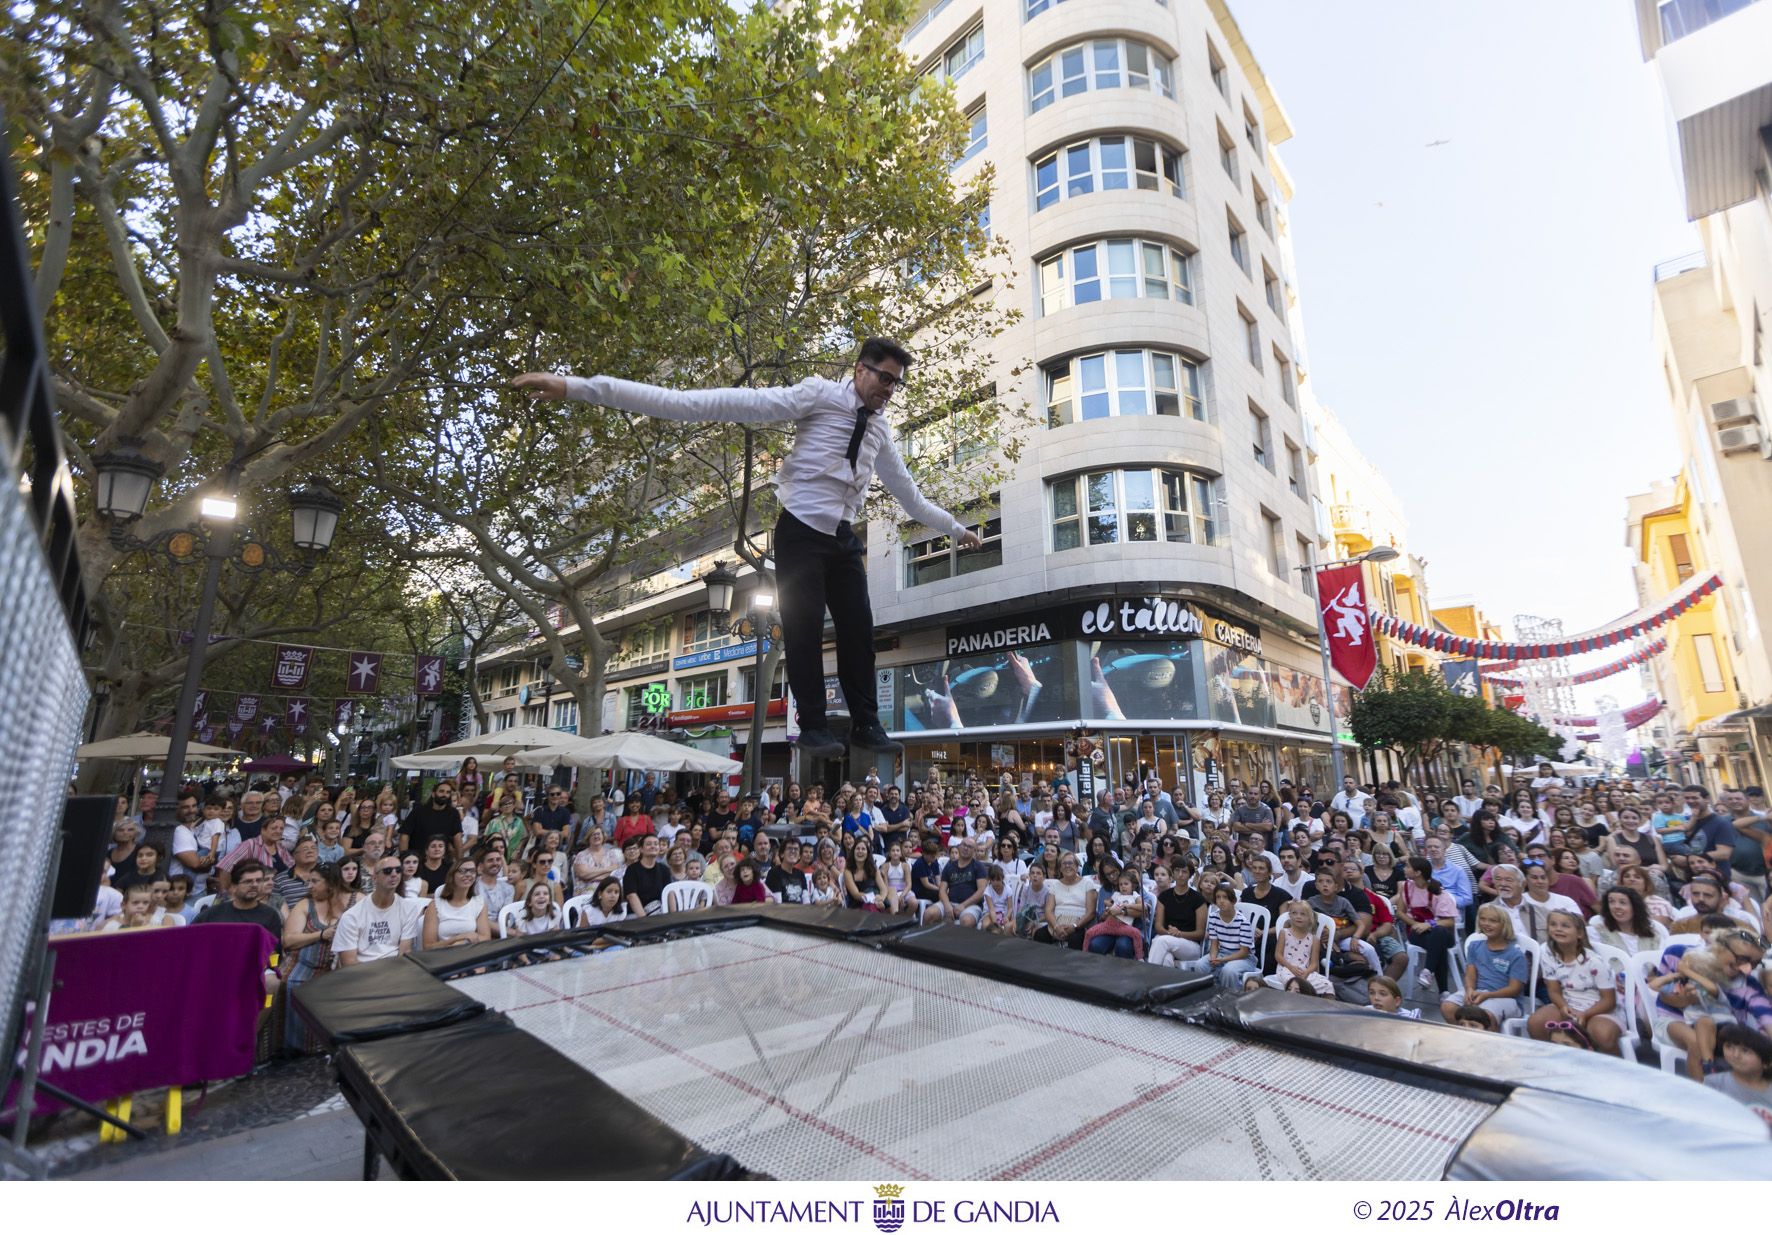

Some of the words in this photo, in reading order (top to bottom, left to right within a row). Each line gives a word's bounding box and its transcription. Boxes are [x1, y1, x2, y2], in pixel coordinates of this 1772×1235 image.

[1081, 602, 1115, 634] el
[948, 622, 1051, 655] PANADERIA
[1216, 620, 1263, 655] CAFETERIA
[40, 1017, 111, 1042] ESTES
[116, 1011, 147, 1031] DE
